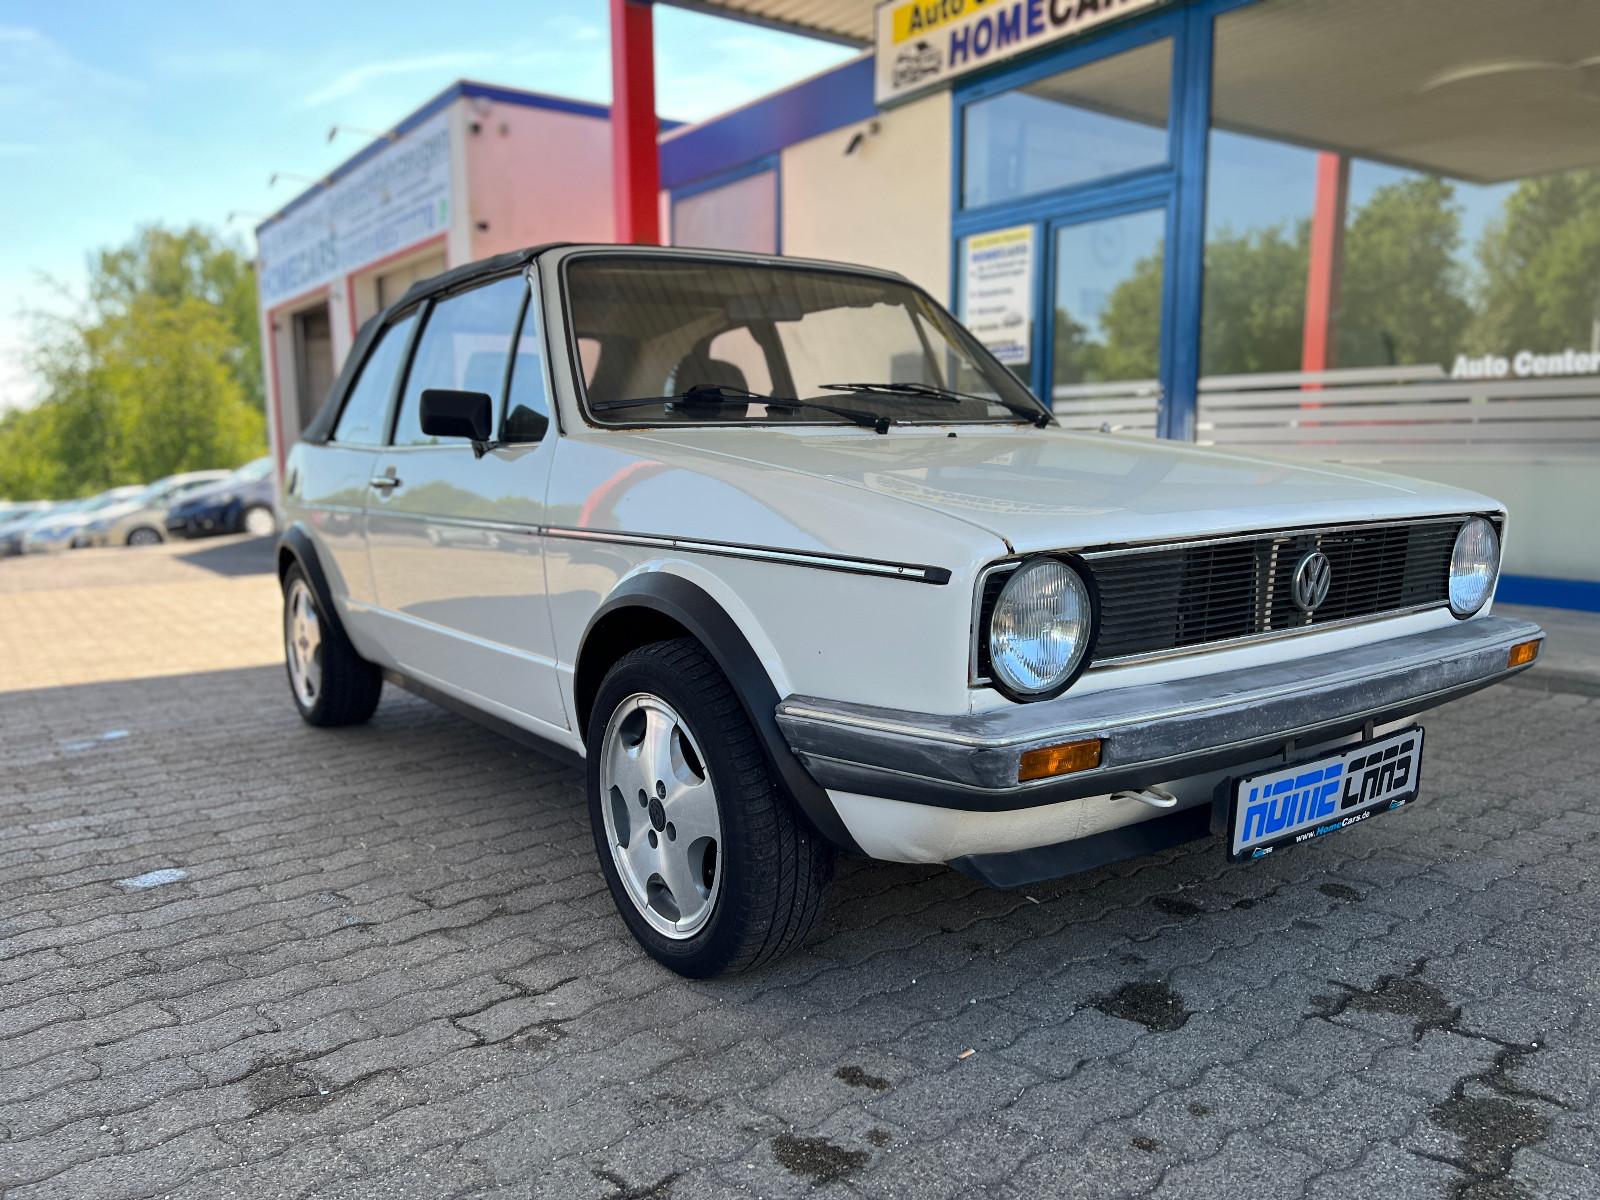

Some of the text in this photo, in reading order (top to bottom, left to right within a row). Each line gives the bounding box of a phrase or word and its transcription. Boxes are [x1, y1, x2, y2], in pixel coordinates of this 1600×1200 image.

[909, 0, 965, 32] Auto
[948, 0, 1128, 67] HOMECA
[1451, 349, 1600, 378] Auto Center
